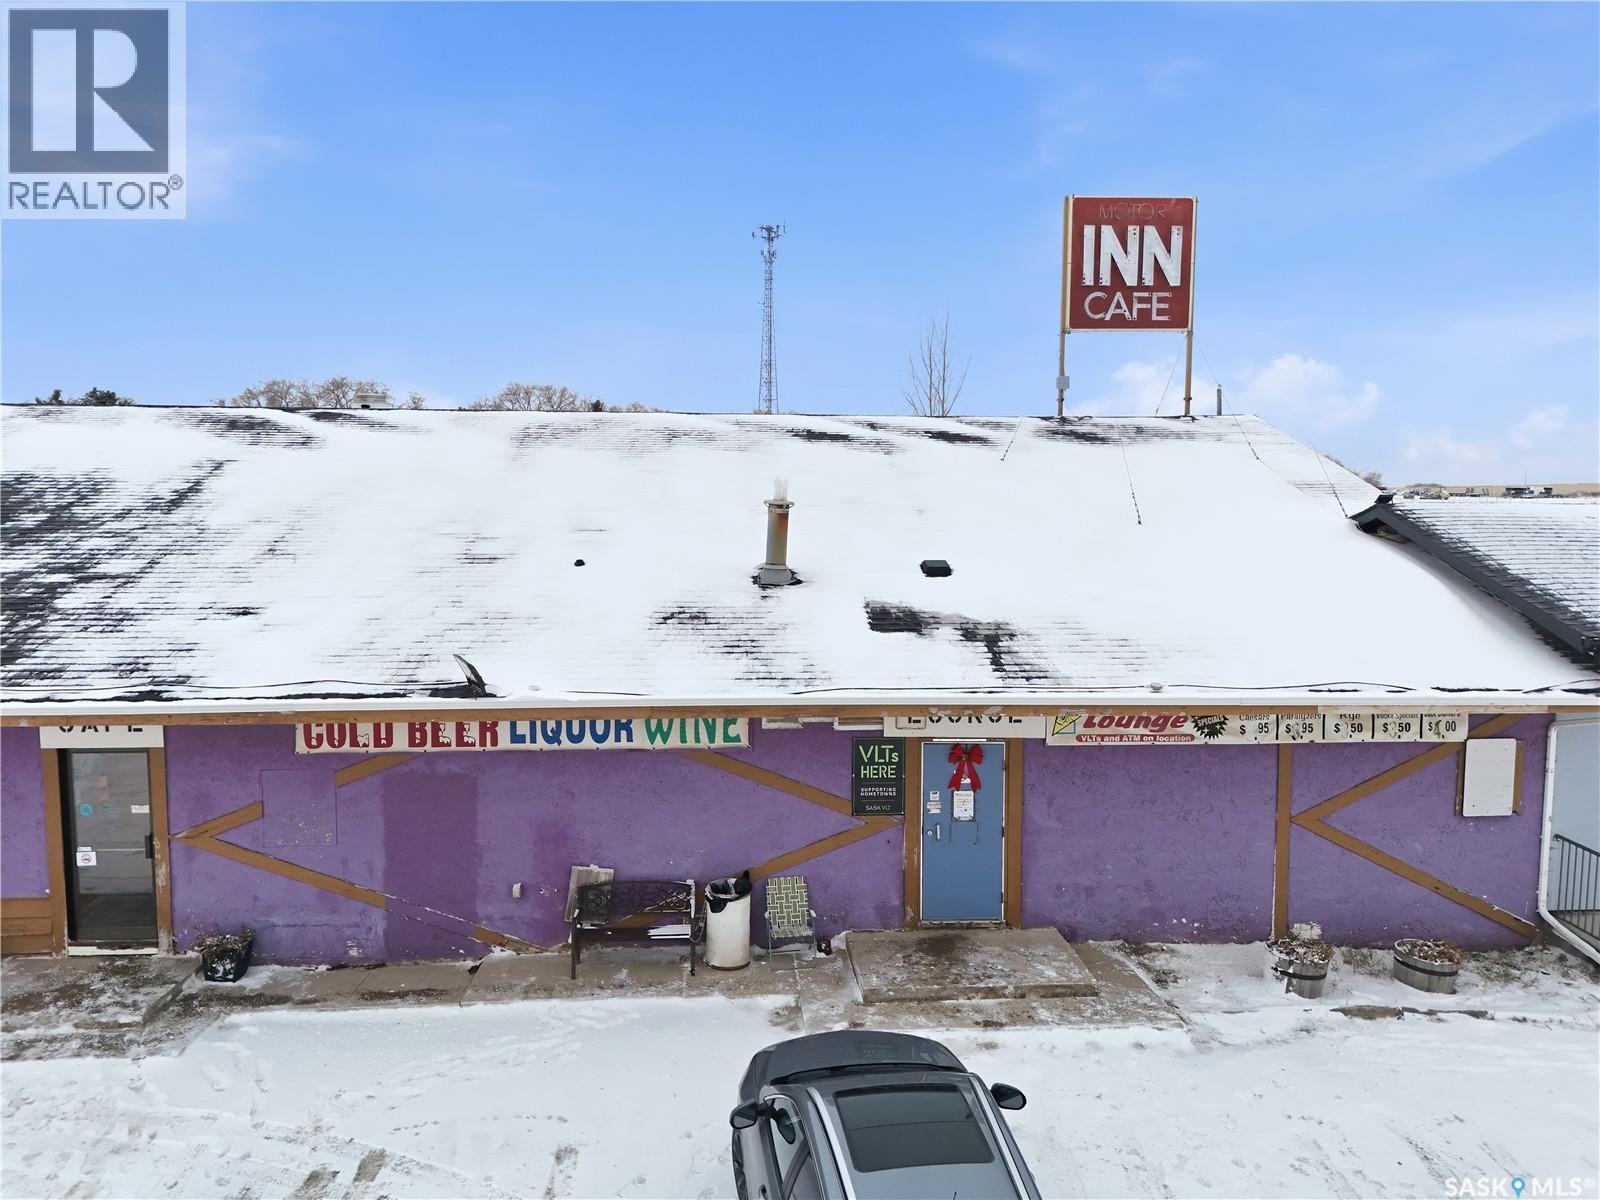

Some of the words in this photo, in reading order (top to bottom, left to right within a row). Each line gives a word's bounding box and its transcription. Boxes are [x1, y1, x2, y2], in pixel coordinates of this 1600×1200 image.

[1100, 203, 1165, 220] MOTOR
[1082, 224, 1184, 286] INN
[1084, 291, 1172, 321] CAFE
[303, 722, 394, 749] COLD
[408, 720, 499, 748] BEER
[509, 719, 634, 746] LIQUOR
[645, 717, 742, 745] WINE
[1156, 734, 1191, 742] location
[858, 745, 899, 763] VLTs
[861, 765, 897, 779] HERE
